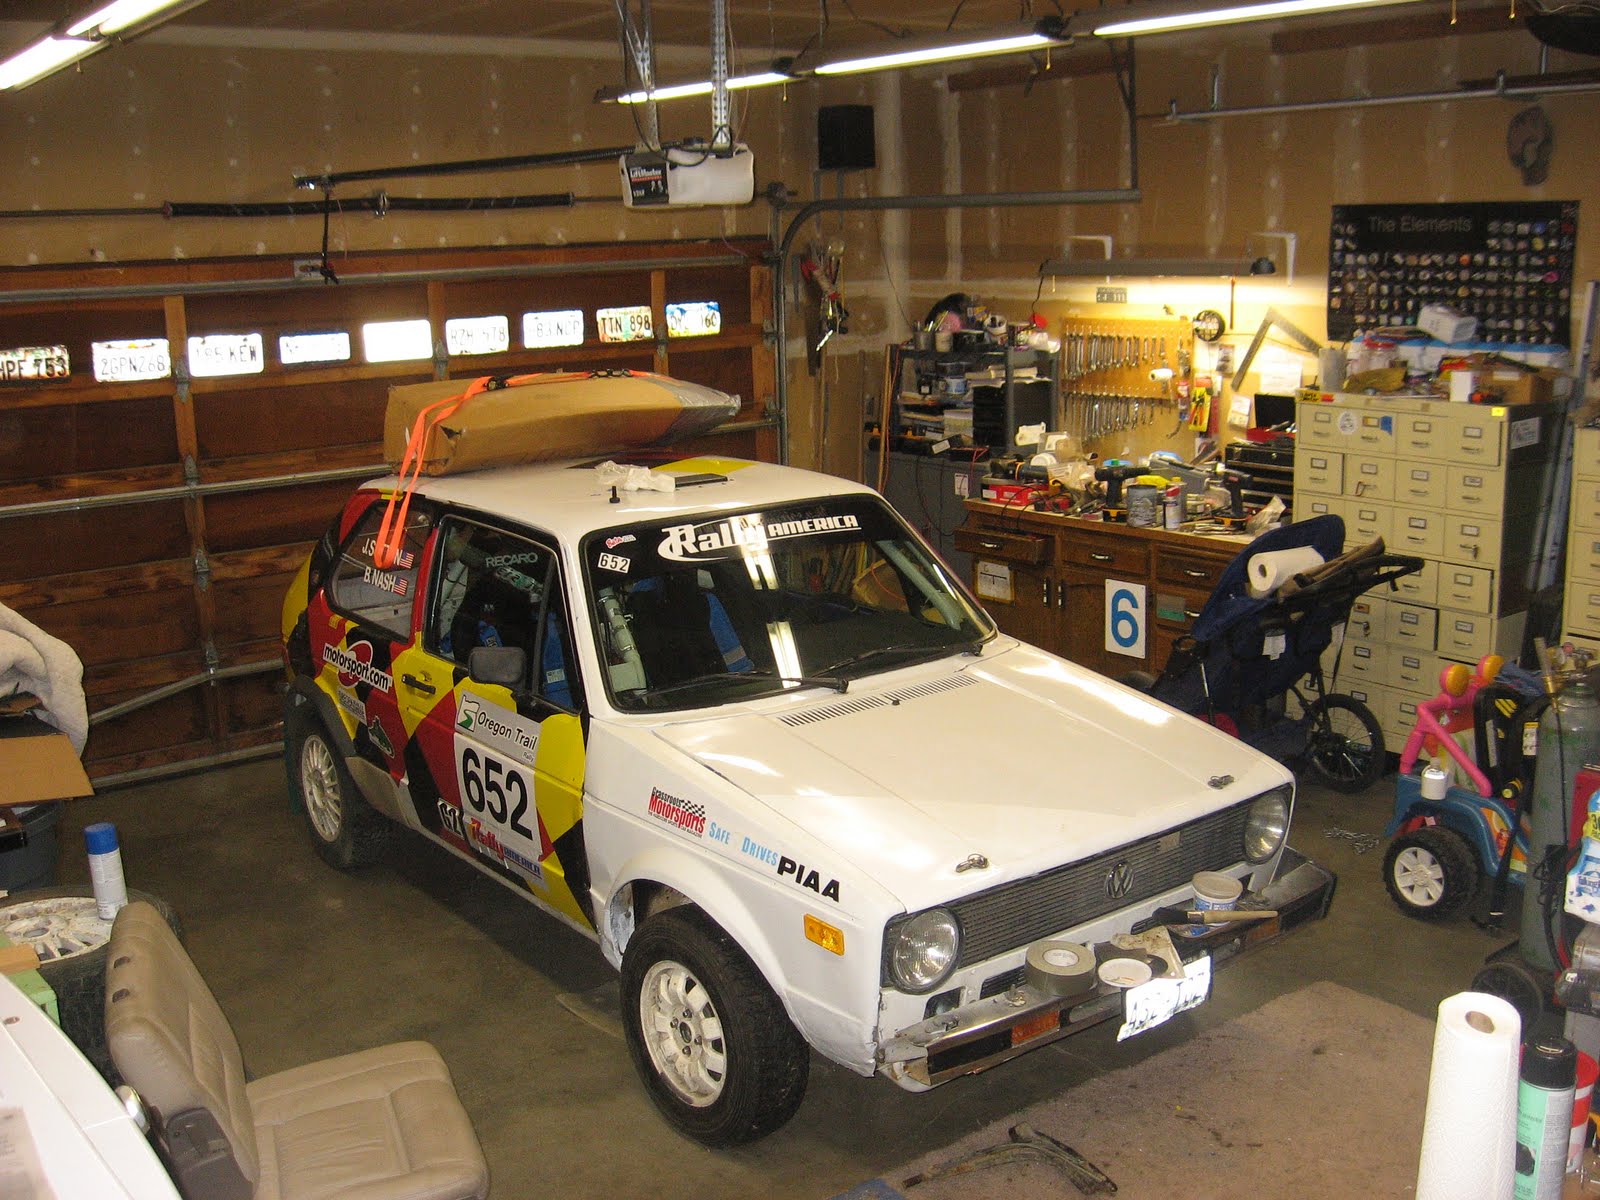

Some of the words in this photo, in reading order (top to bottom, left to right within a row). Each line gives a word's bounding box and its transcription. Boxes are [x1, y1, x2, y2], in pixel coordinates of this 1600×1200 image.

[1368, 216, 1395, 233] The
[1400, 215, 1472, 233] Elements
[629, 313, 651, 331] 898
[34, 357, 67, 378] 753
[101, 354, 166, 376] 2GPN268
[768, 515, 859, 538] AMERICA
[485, 551, 539, 568] RECARO
[600, 554, 630, 573] 652
[1110, 588, 1140, 649] 6
[323, 645, 390, 691] motorsport.com
[477, 711, 512, 739] Oregon
[514, 727, 538, 751] Trail
[522, 750, 535, 763] Rally
[462, 747, 534, 841] 652
[651, 786, 682, 809] Grassroots
[648, 794, 707, 834] Motorsports
[468, 817, 505, 862] Rally
[708, 821, 731, 845] SAFE
[741, 836, 779, 867] DRIVES
[776, 855, 841, 903] PIAA
